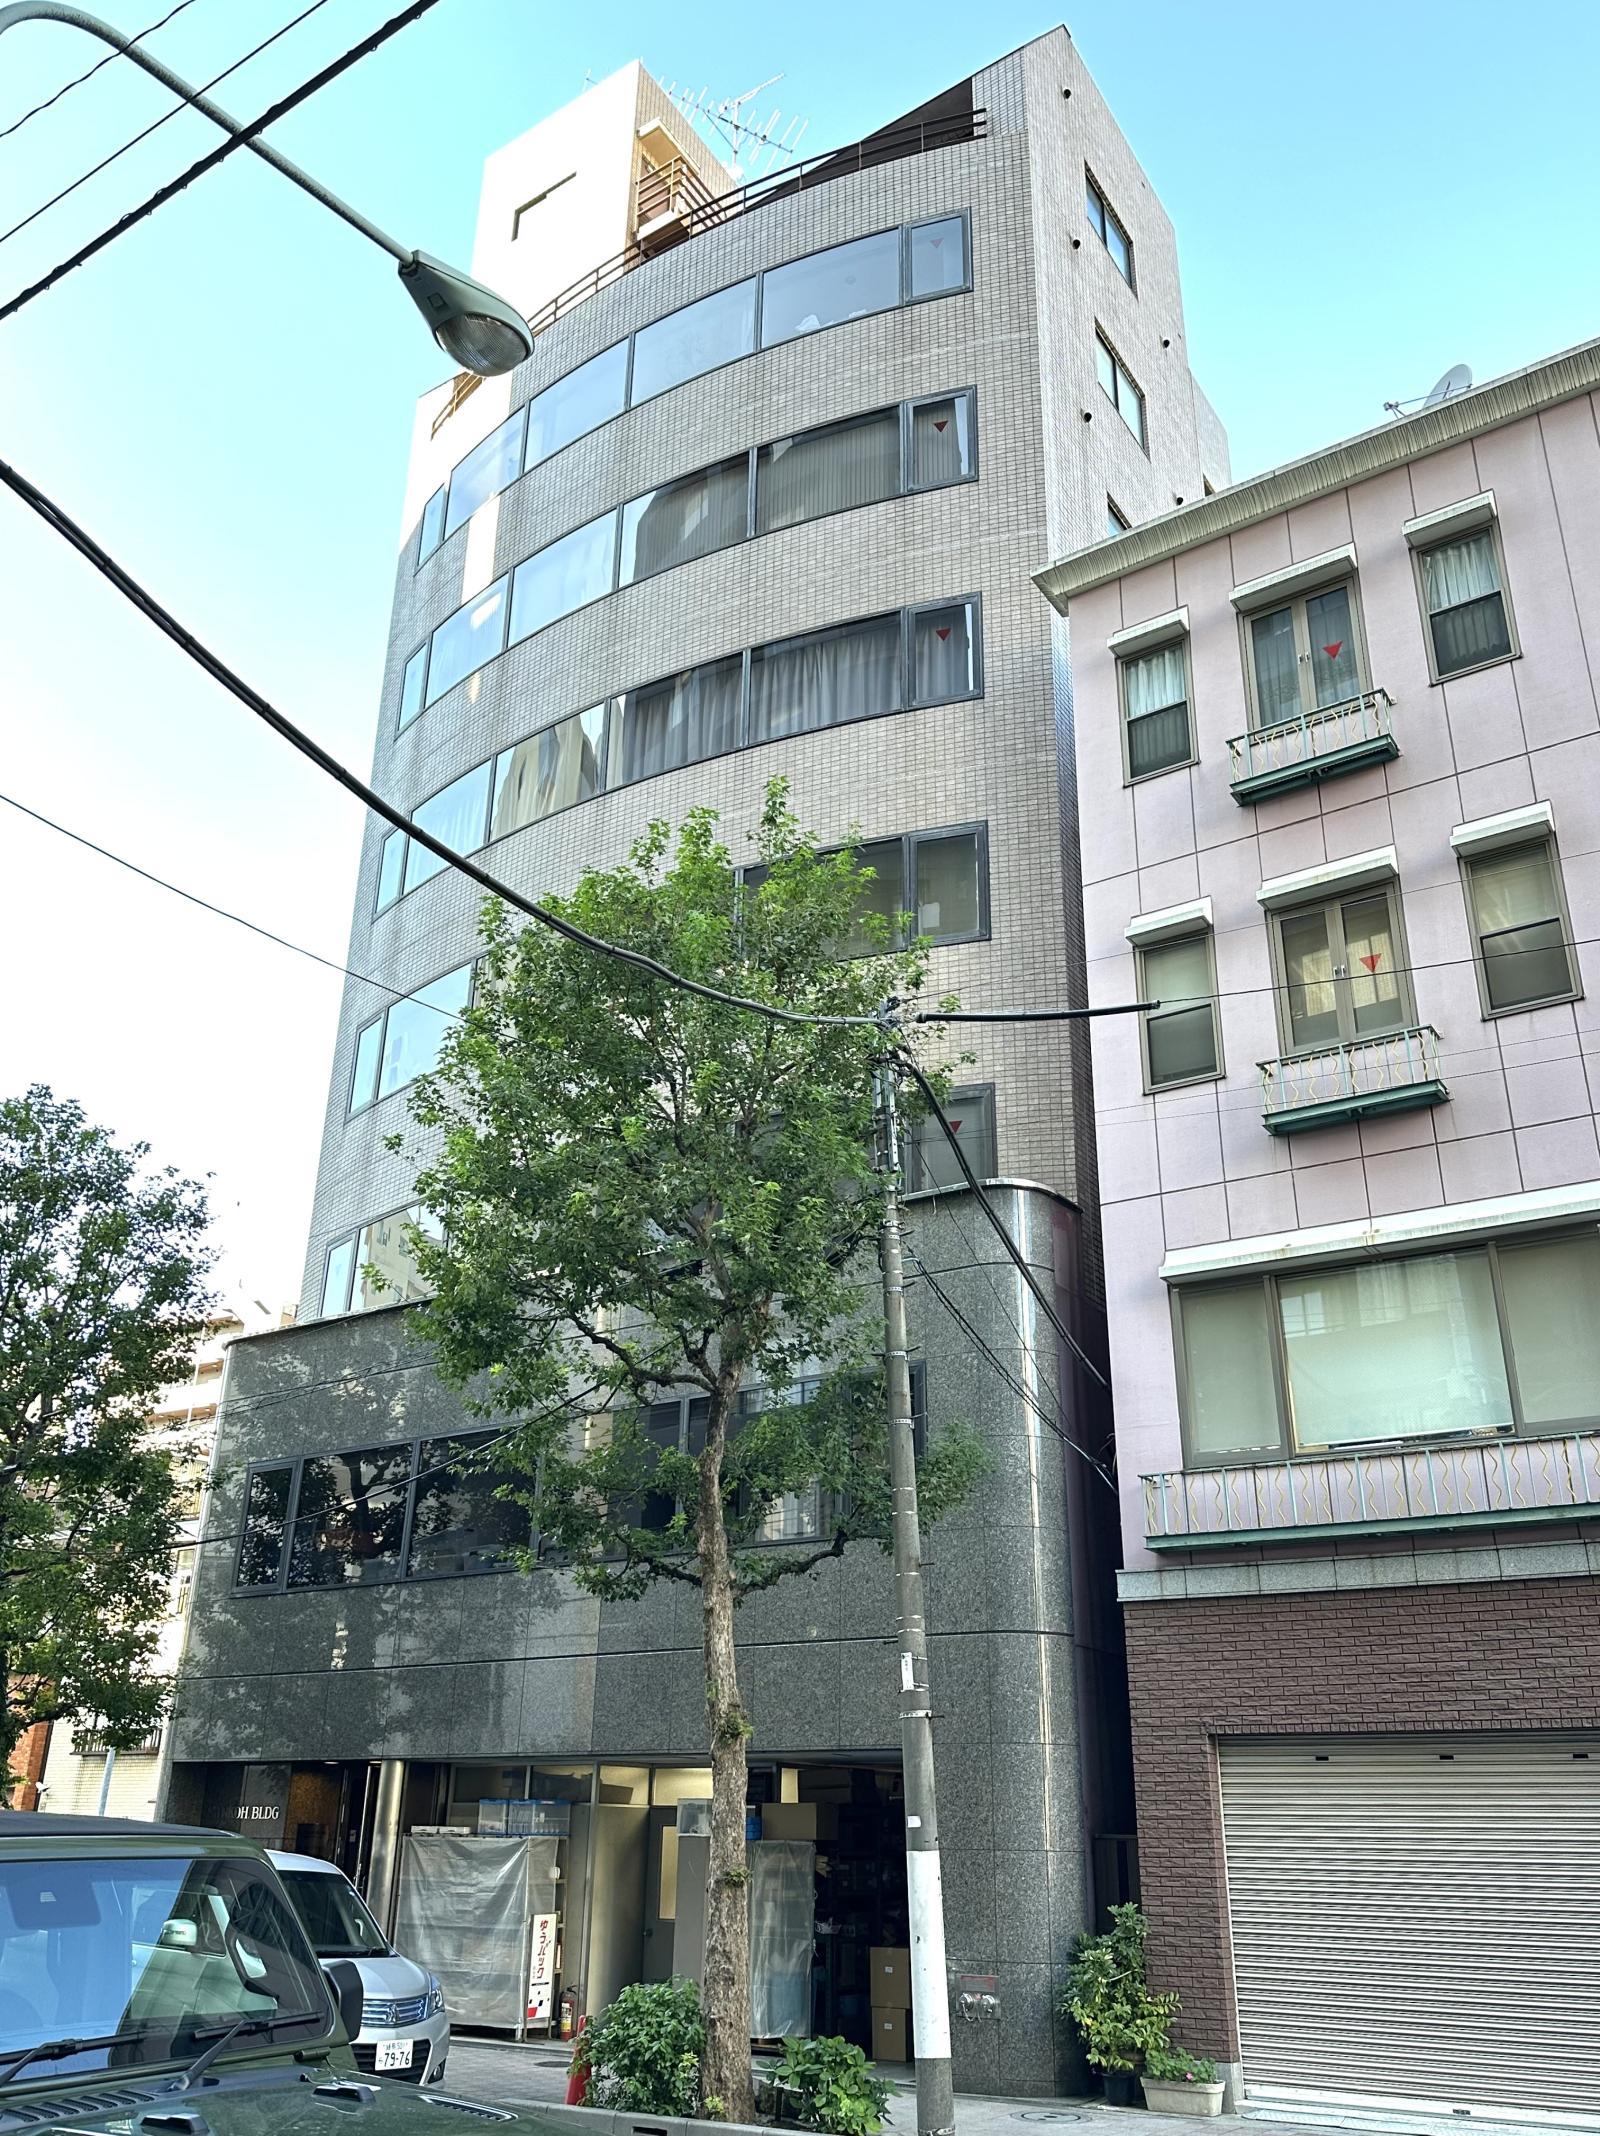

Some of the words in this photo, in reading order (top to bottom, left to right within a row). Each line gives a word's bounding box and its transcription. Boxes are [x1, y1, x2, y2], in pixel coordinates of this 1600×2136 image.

[251, 1806, 280, 1820] BLDG
[536, 1919, 551, 1979] ゆうパック
[384, 2051, 411, 2067] 79-76
